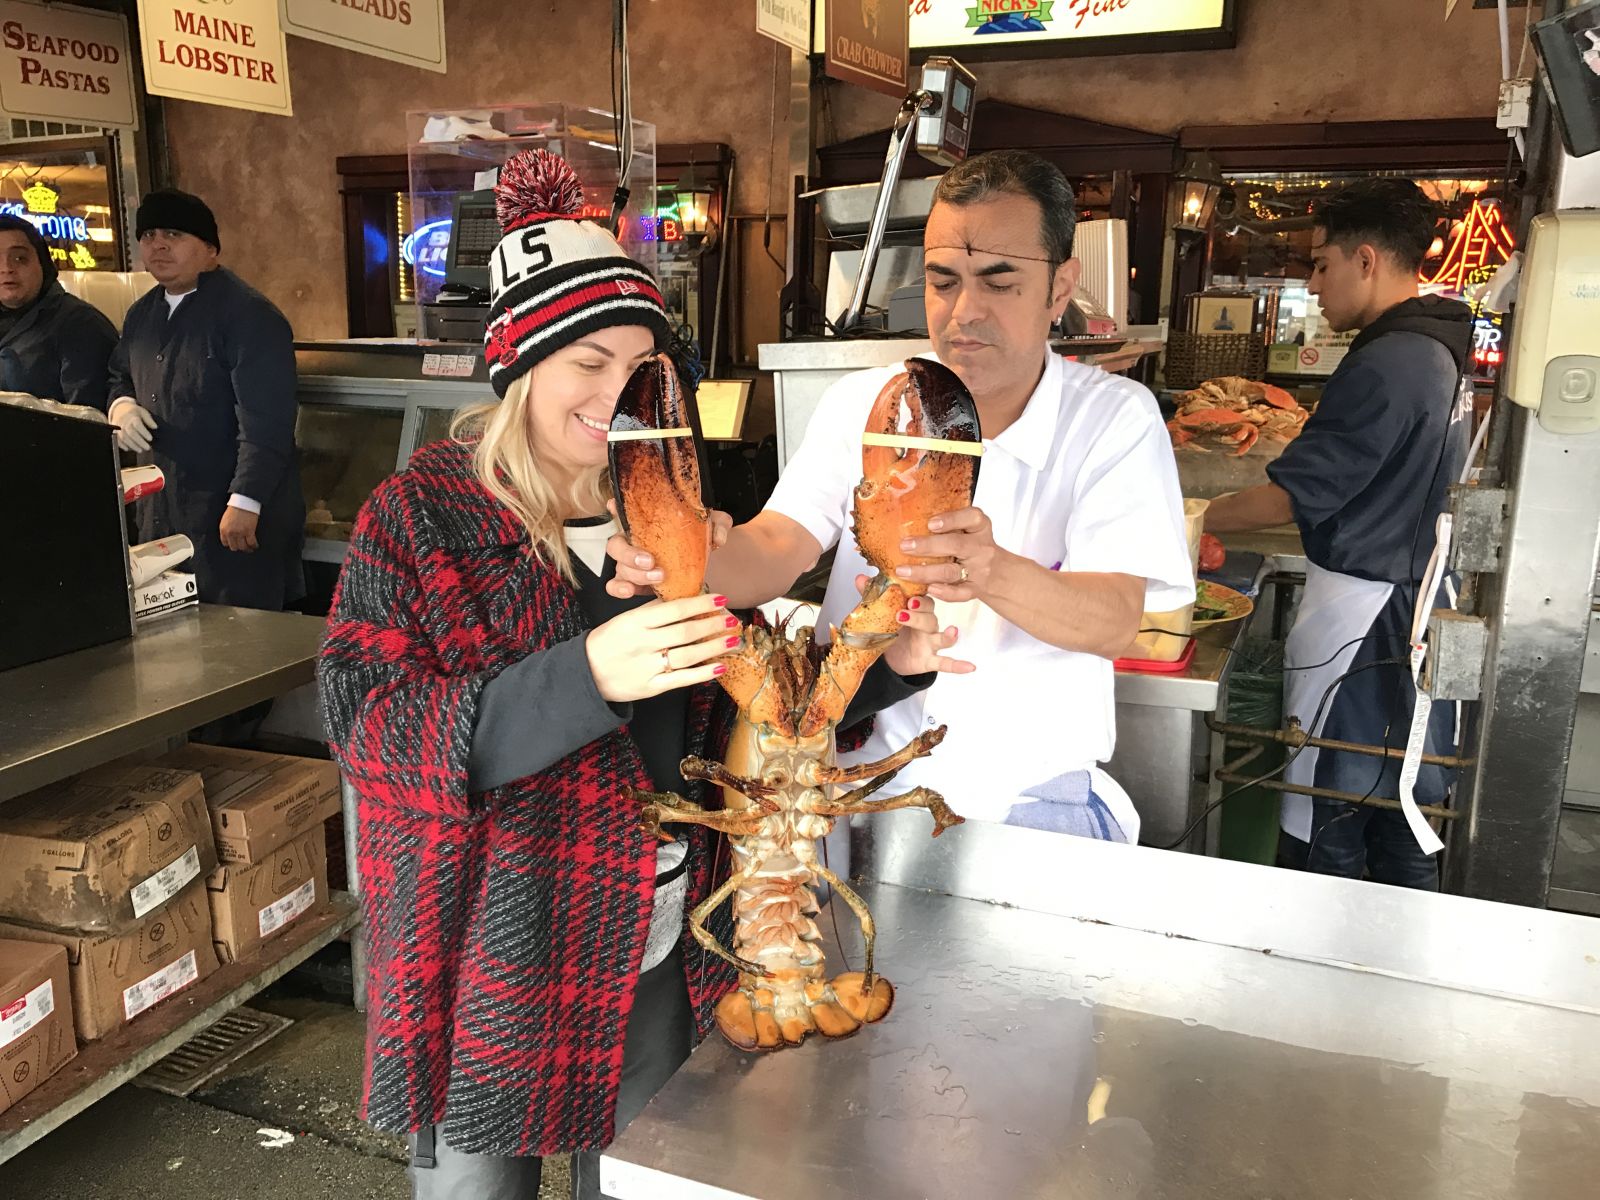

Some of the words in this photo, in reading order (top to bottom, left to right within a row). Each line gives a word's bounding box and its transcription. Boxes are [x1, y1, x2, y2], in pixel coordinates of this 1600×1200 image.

[981, 0, 1039, 13] NICK'S
[173, 9, 256, 48] MAINE
[157, 39, 278, 84] LOBSTER
[836, 35, 862, 64] CRAB
[861, 45, 903, 78] CHOWDER
[143, 587, 175, 605] Karat
